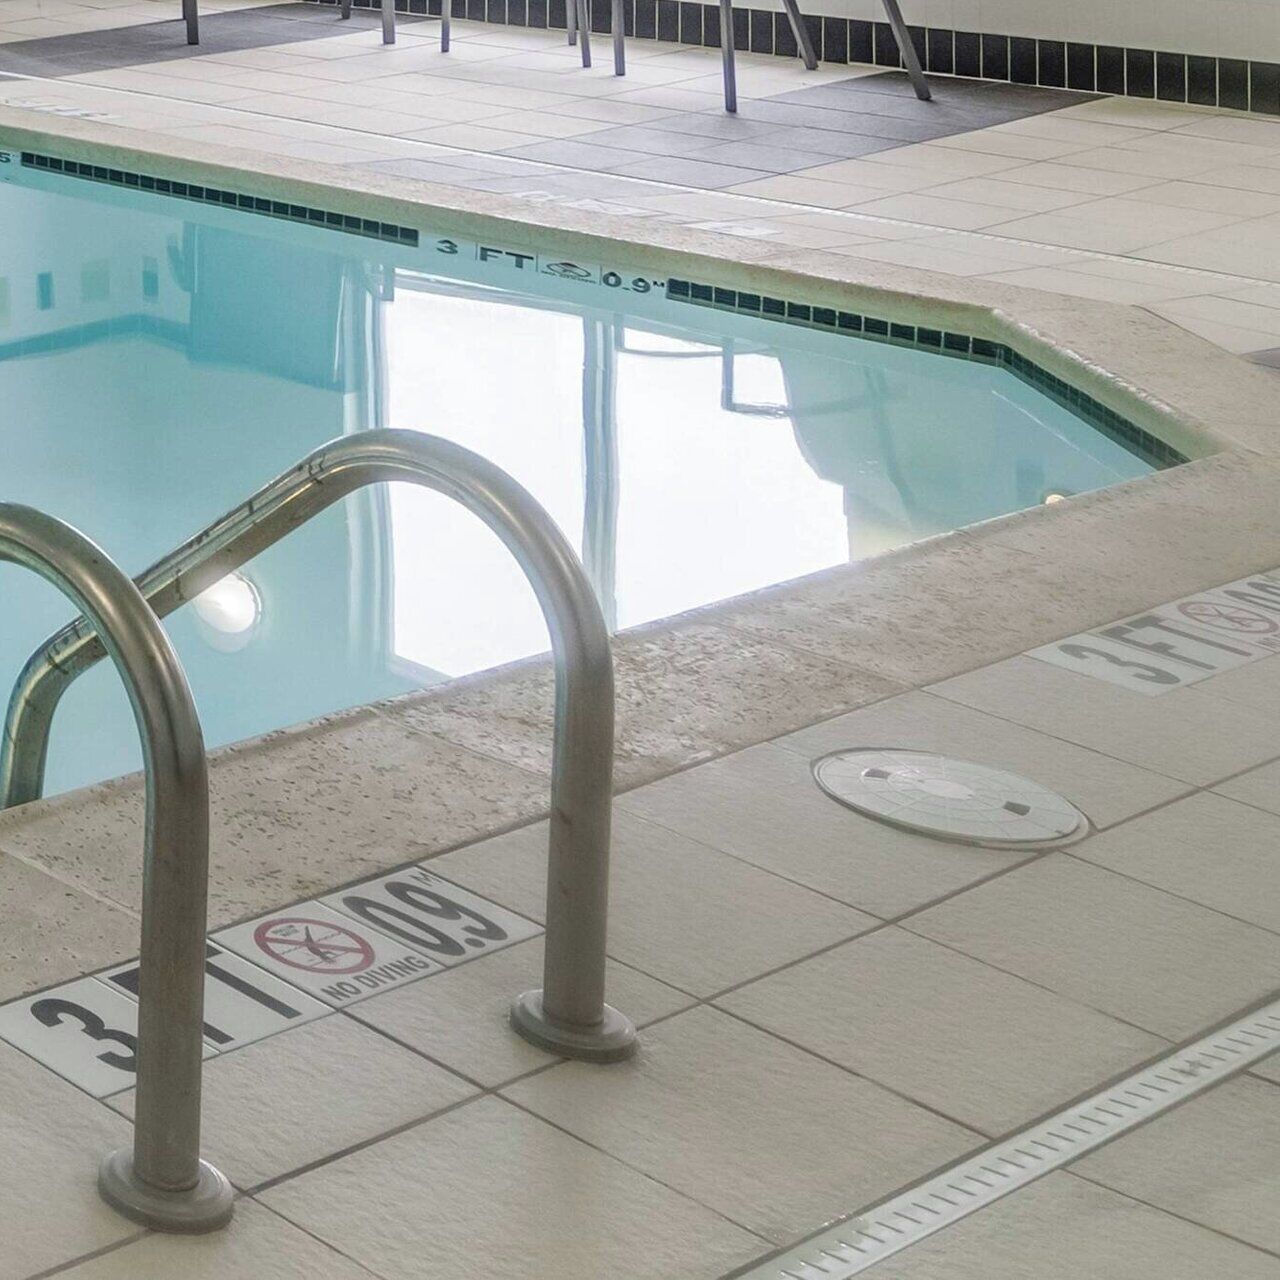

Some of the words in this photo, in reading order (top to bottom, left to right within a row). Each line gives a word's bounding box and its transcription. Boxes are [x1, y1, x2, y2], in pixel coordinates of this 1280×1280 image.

[436, 239, 459, 255] 3
[479, 246, 534, 269] FT
[1058, 642, 1183, 685] 3
[1099, 615, 1253, 670] FT
[321, 981, 362, 1001] NO
[353, 955, 430, 988] DIVING
[30, 998, 138, 1072] 3
